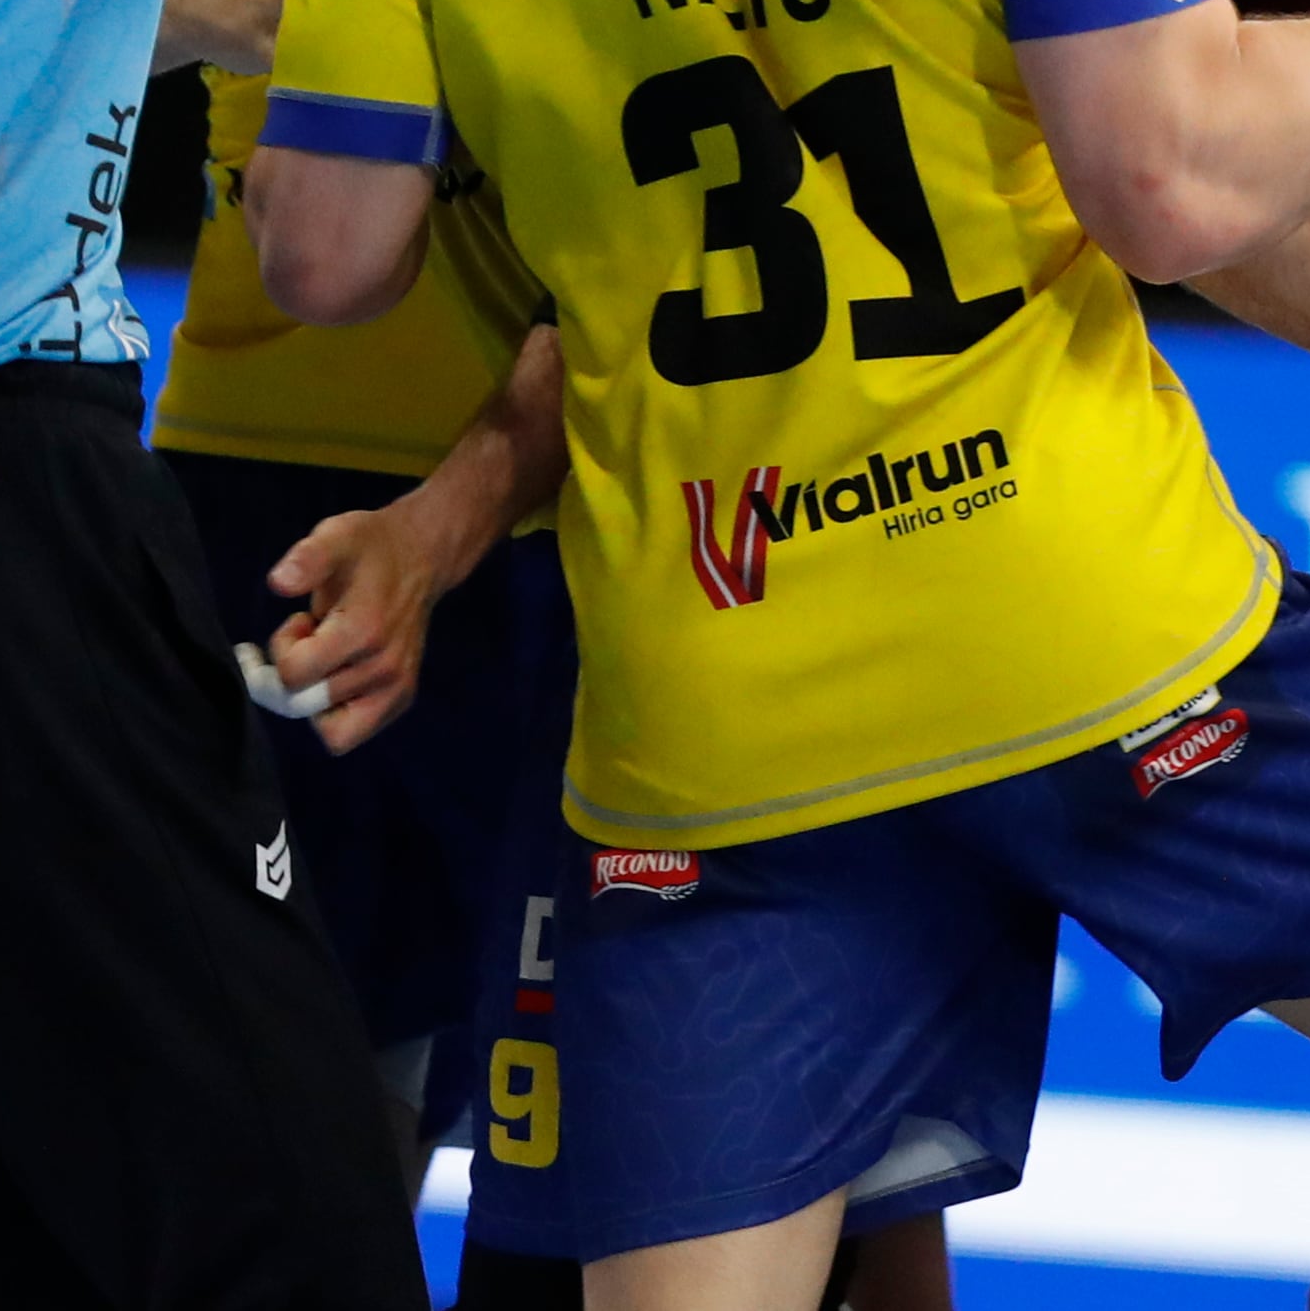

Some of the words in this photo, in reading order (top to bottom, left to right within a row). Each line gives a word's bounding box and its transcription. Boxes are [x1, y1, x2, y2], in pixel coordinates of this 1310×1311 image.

[621, 53, 1027, 387] 31
[883, 501, 945, 540] Hiria
[952, 478, 1019, 522] gara
[1142, 718, 1237, 784] RECONDO
[597, 851, 691, 884] RECONDO
[489, 1037, 559, 1169] 9
